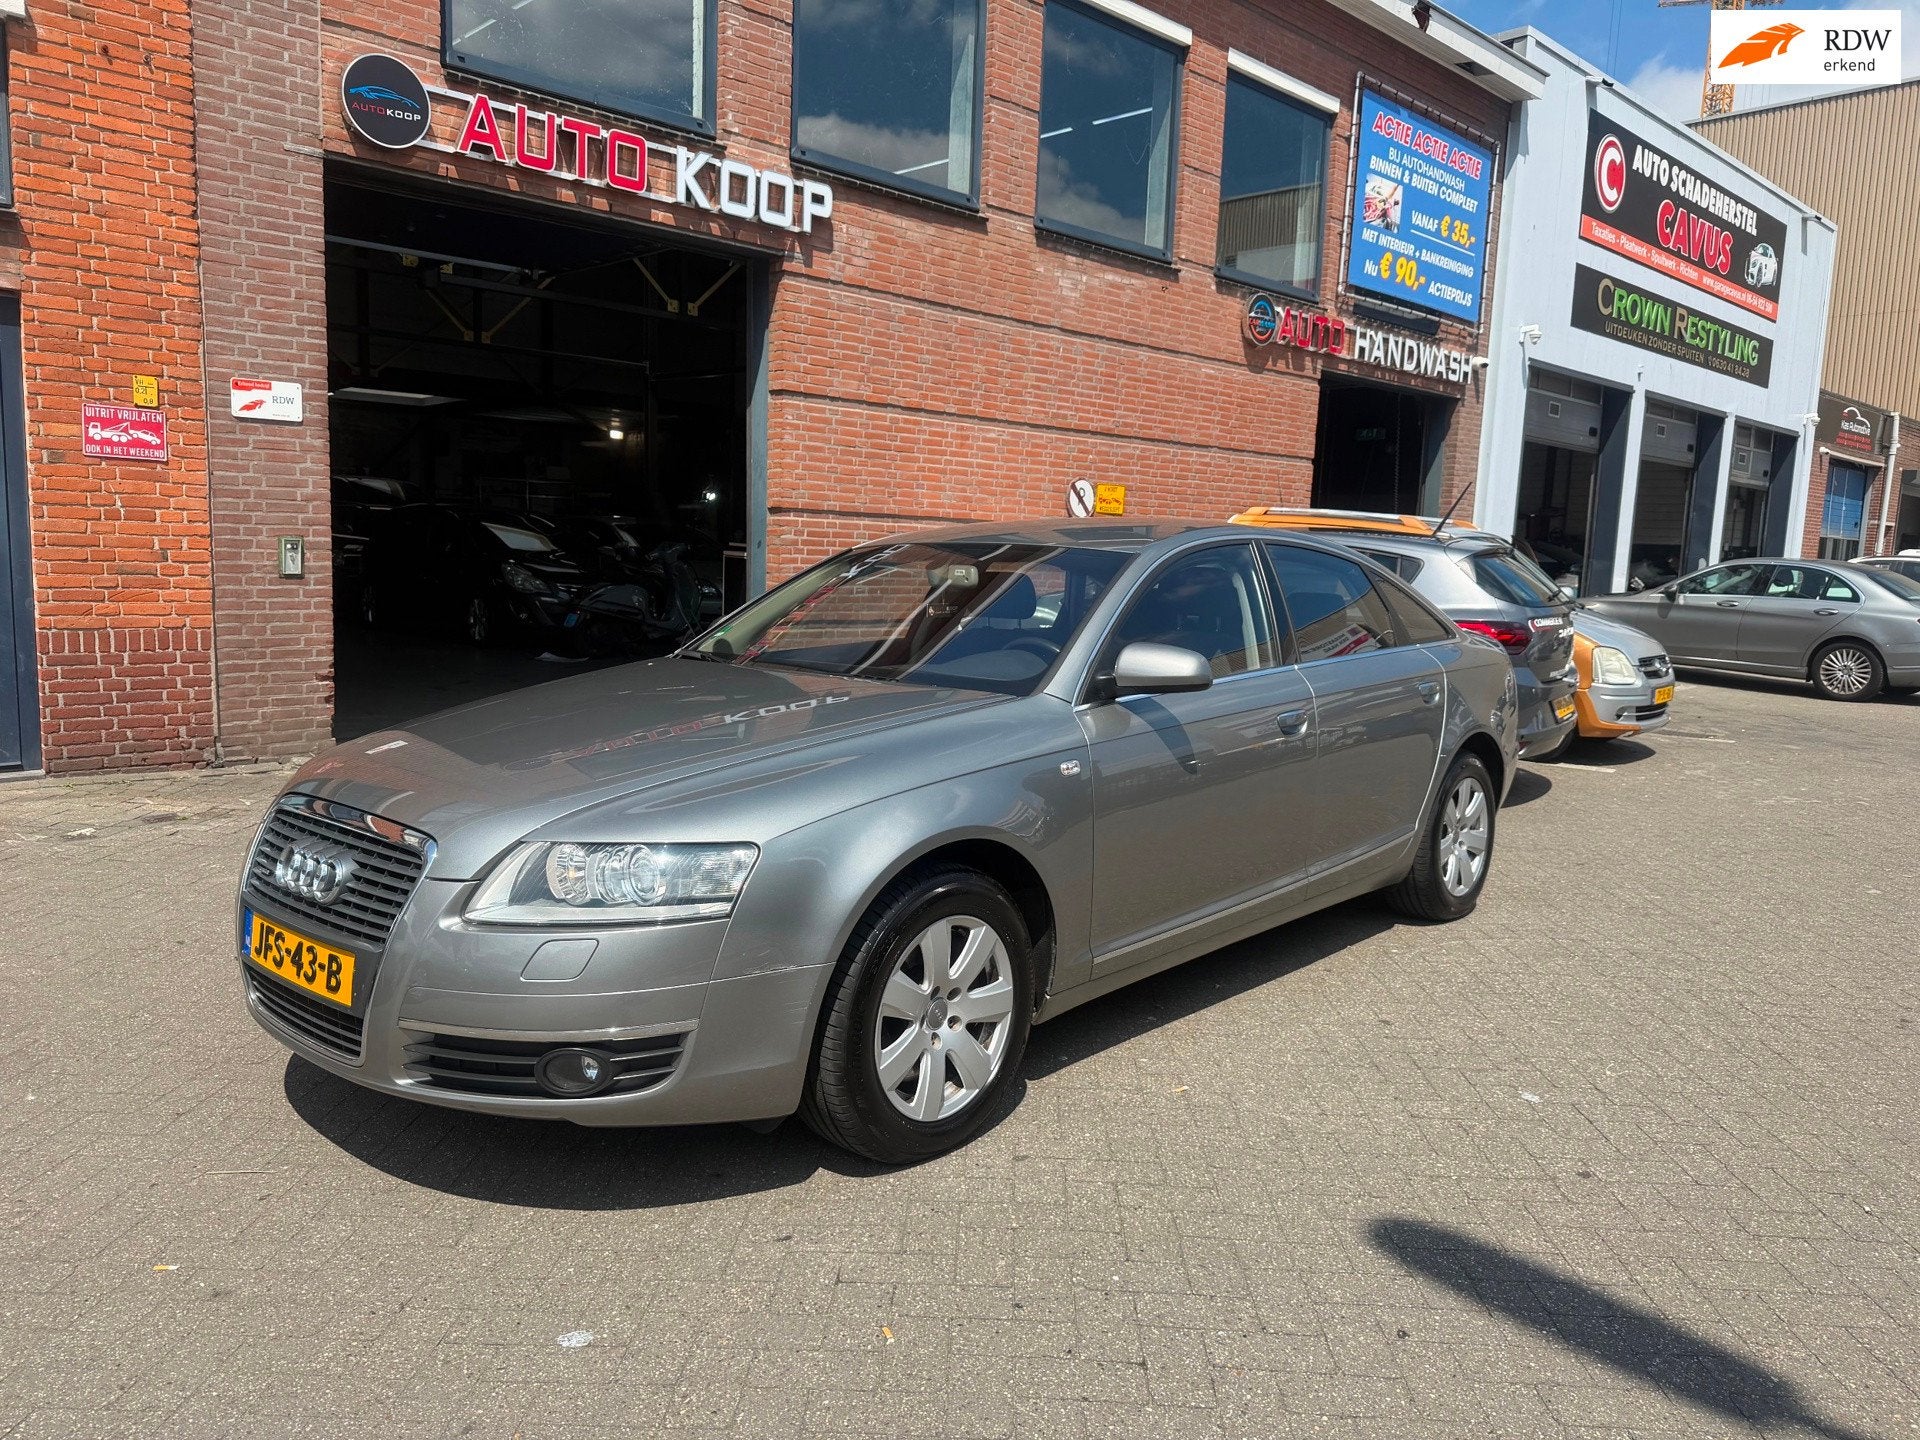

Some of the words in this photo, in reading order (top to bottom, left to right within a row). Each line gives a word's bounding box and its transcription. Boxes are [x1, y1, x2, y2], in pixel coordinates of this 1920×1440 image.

[456, 92, 648, 194] AUTO
[676, 145, 833, 234] KOOP
[1372, 112, 1412, 146] ACTIE
[1412, 130, 1449, 163] ACTIE
[1448, 148, 1482, 180] ACTIE
[1389, 147, 1401, 164] BIJ
[1402, 153, 1465, 192] AUTOHANDWASH
[1370, 155, 1402, 180] BINNEN
[1403, 170, 1410, 184] &
[1411, 173, 1439, 196] BUITEN
[1440, 186, 1478, 213] COMPLEET
[1632, 145, 1670, 187] AUTO
[1670, 165, 1758, 236] SCHADEHERSTEL
[1411, 211, 1438, 232] VANAF
[1591, 222, 1616, 244] Taxaties
[1620, 235, 1647, 257] Plaatwerk
[1656, 199, 1733, 275] CAVUS
[1362, 228, 1378, 243] MET
[1378, 232, 1415, 256] INTERIEUR
[1421, 249, 1474, 278] BANKREINIGING
[1428, 281, 1473, 307] ACTIEPRIJS
[1277, 306, 1345, 354] AUTO
[1354, 326, 1473, 385] HANDWASH
[1605, 321, 1647, 344] UITDEUKEN
[1648, 336, 1676, 355] ZONDER
[1676, 345, 1704, 363] SPUITEN
[85, 406, 115, 419] UITRIT
[117, 409, 162, 423] VRIJLATEN
[272, 395, 294, 405] RDW
[86, 444, 100, 453] OOK
[103, 445, 111, 453] IN
[113, 446, 127, 455] HET
[129, 447, 164, 457] WEEKEND
[255, 922, 342, 995] JFS-43-B
